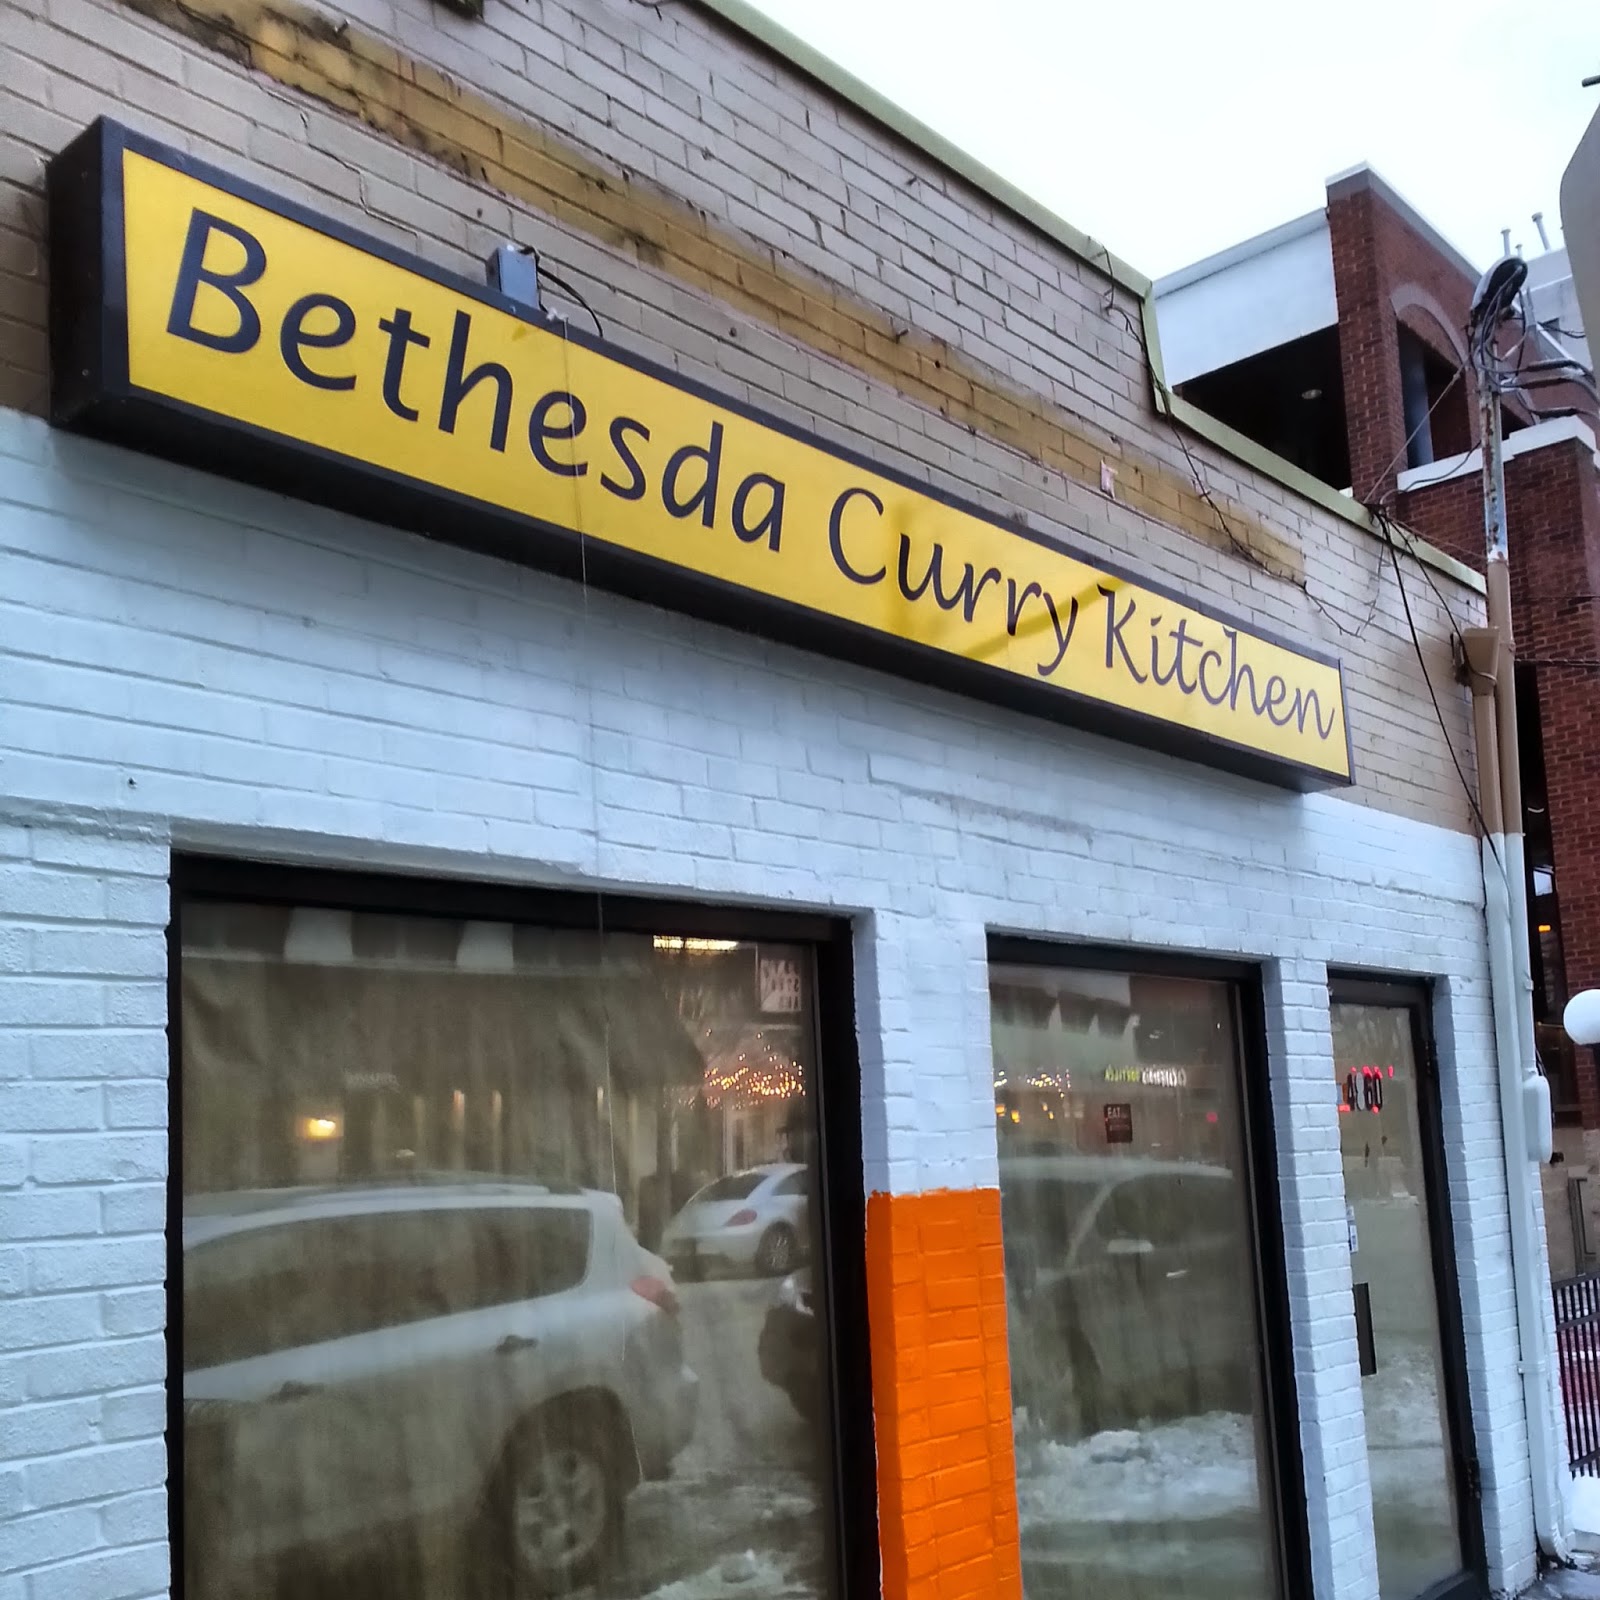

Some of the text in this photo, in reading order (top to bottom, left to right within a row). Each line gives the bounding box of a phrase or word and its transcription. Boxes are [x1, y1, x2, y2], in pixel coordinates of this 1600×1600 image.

[167, 207, 1335, 740] Bethesda Curry Kitchen
